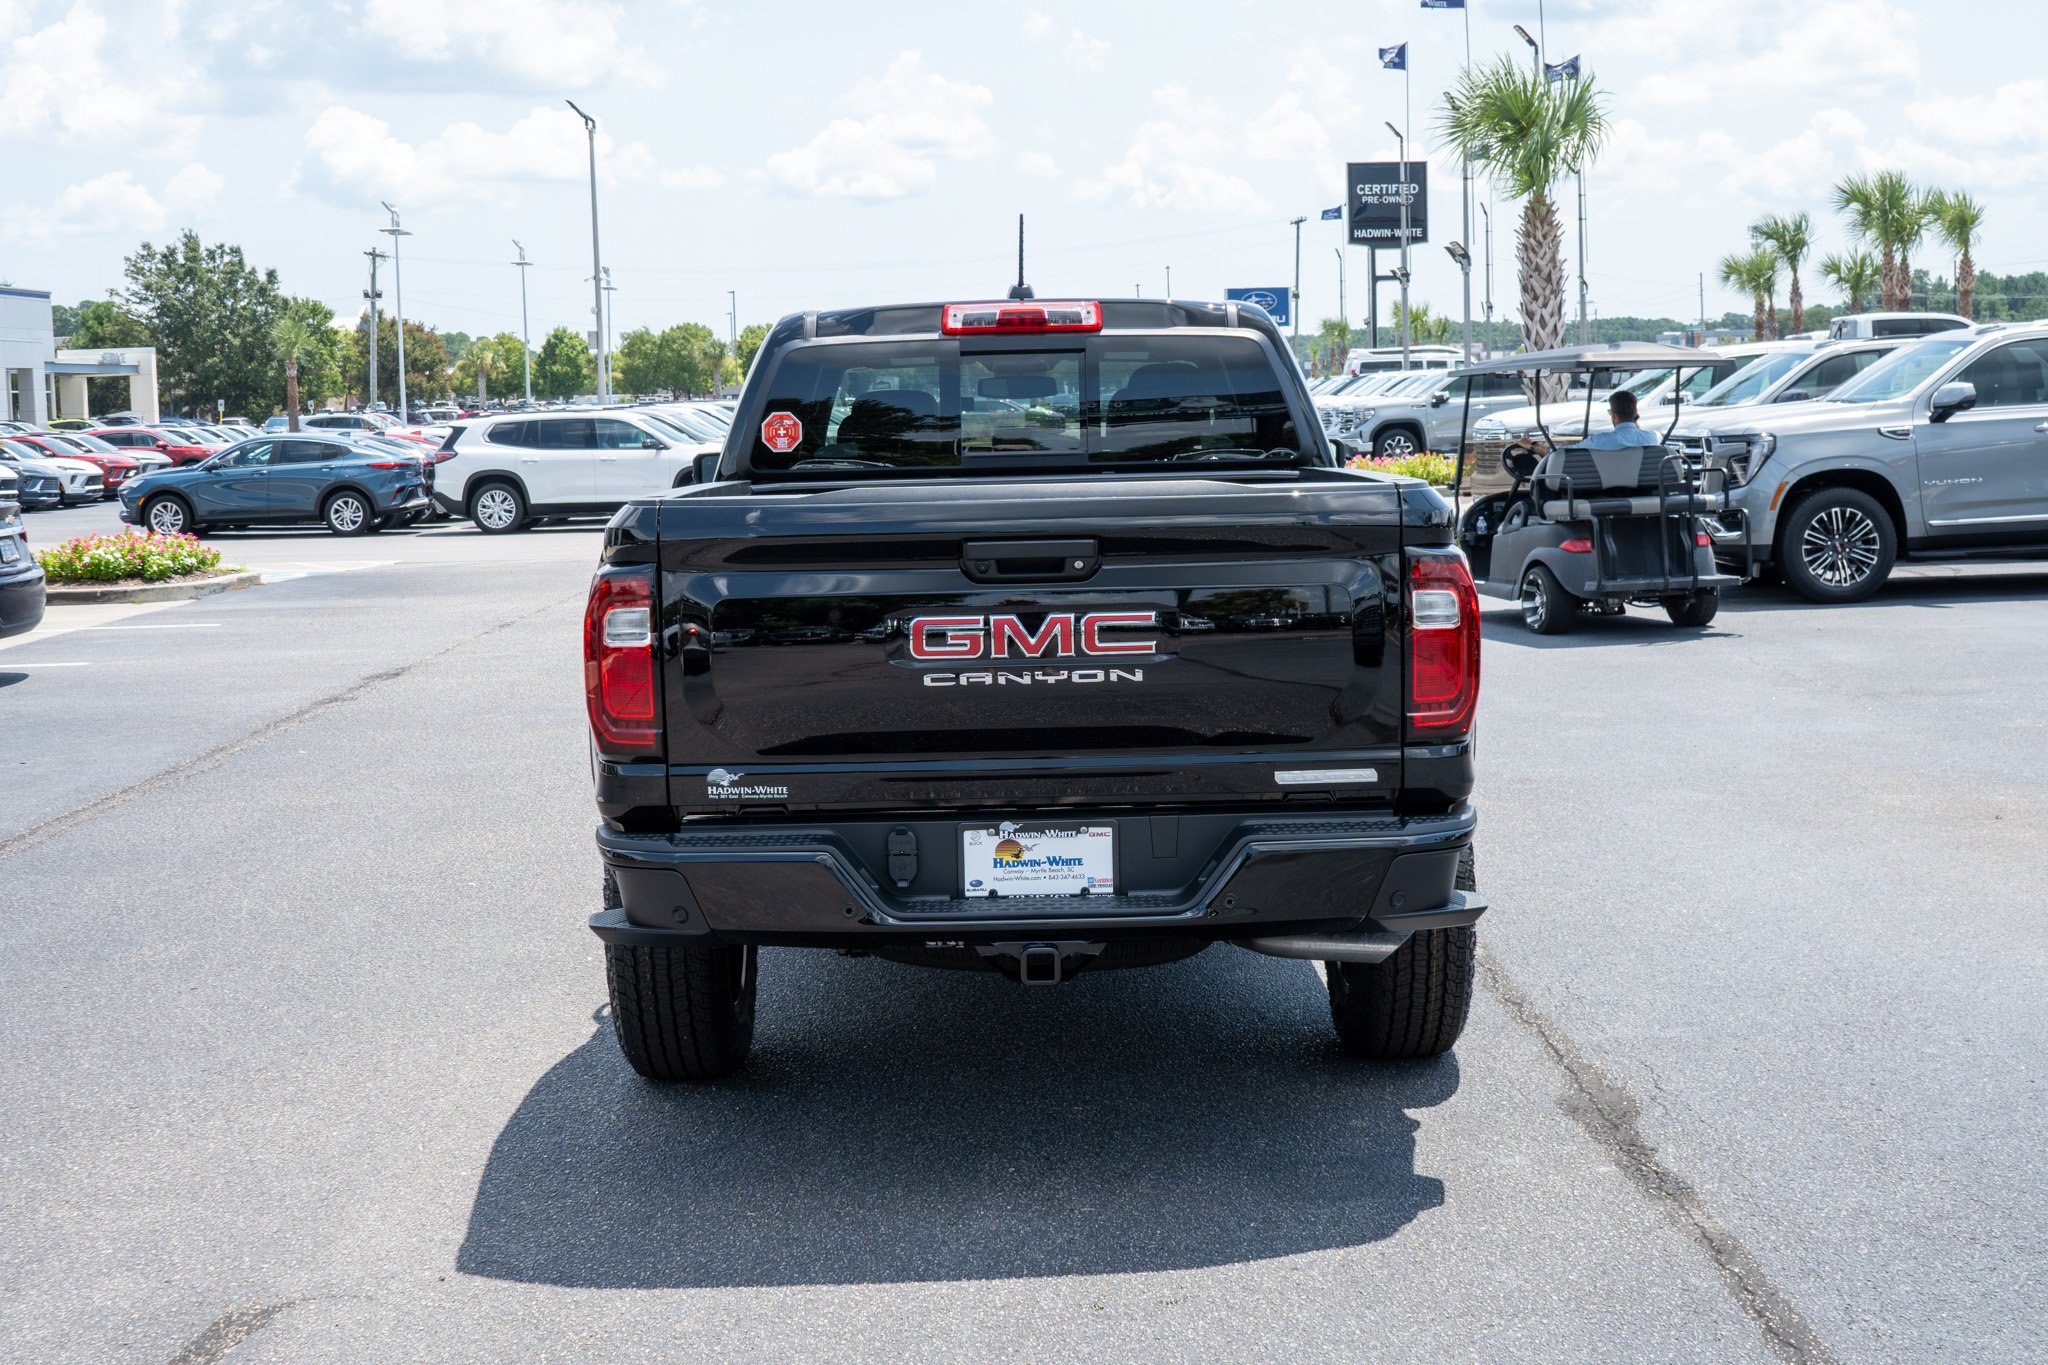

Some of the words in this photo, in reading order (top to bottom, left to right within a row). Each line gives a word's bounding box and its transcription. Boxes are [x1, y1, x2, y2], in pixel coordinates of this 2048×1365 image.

[1356, 183, 1419, 195] CERTIFIED
[1362, 195, 1414, 204] PRE-OWNED
[1924, 477, 1983, 486] YUKON
[909, 611, 1157, 660] GMC
[923, 668, 1144, 687] CANYON
[707, 785, 789, 795] HADWIN-WHITE
[999, 829, 1078, 840] HADWIN-WHITE
[993, 855, 1084, 869] HADWIN-WHITE
[993, 874, 1042, 882] Hadwin-White.com
[1048, 873, 1085, 881] 843-347-4633
